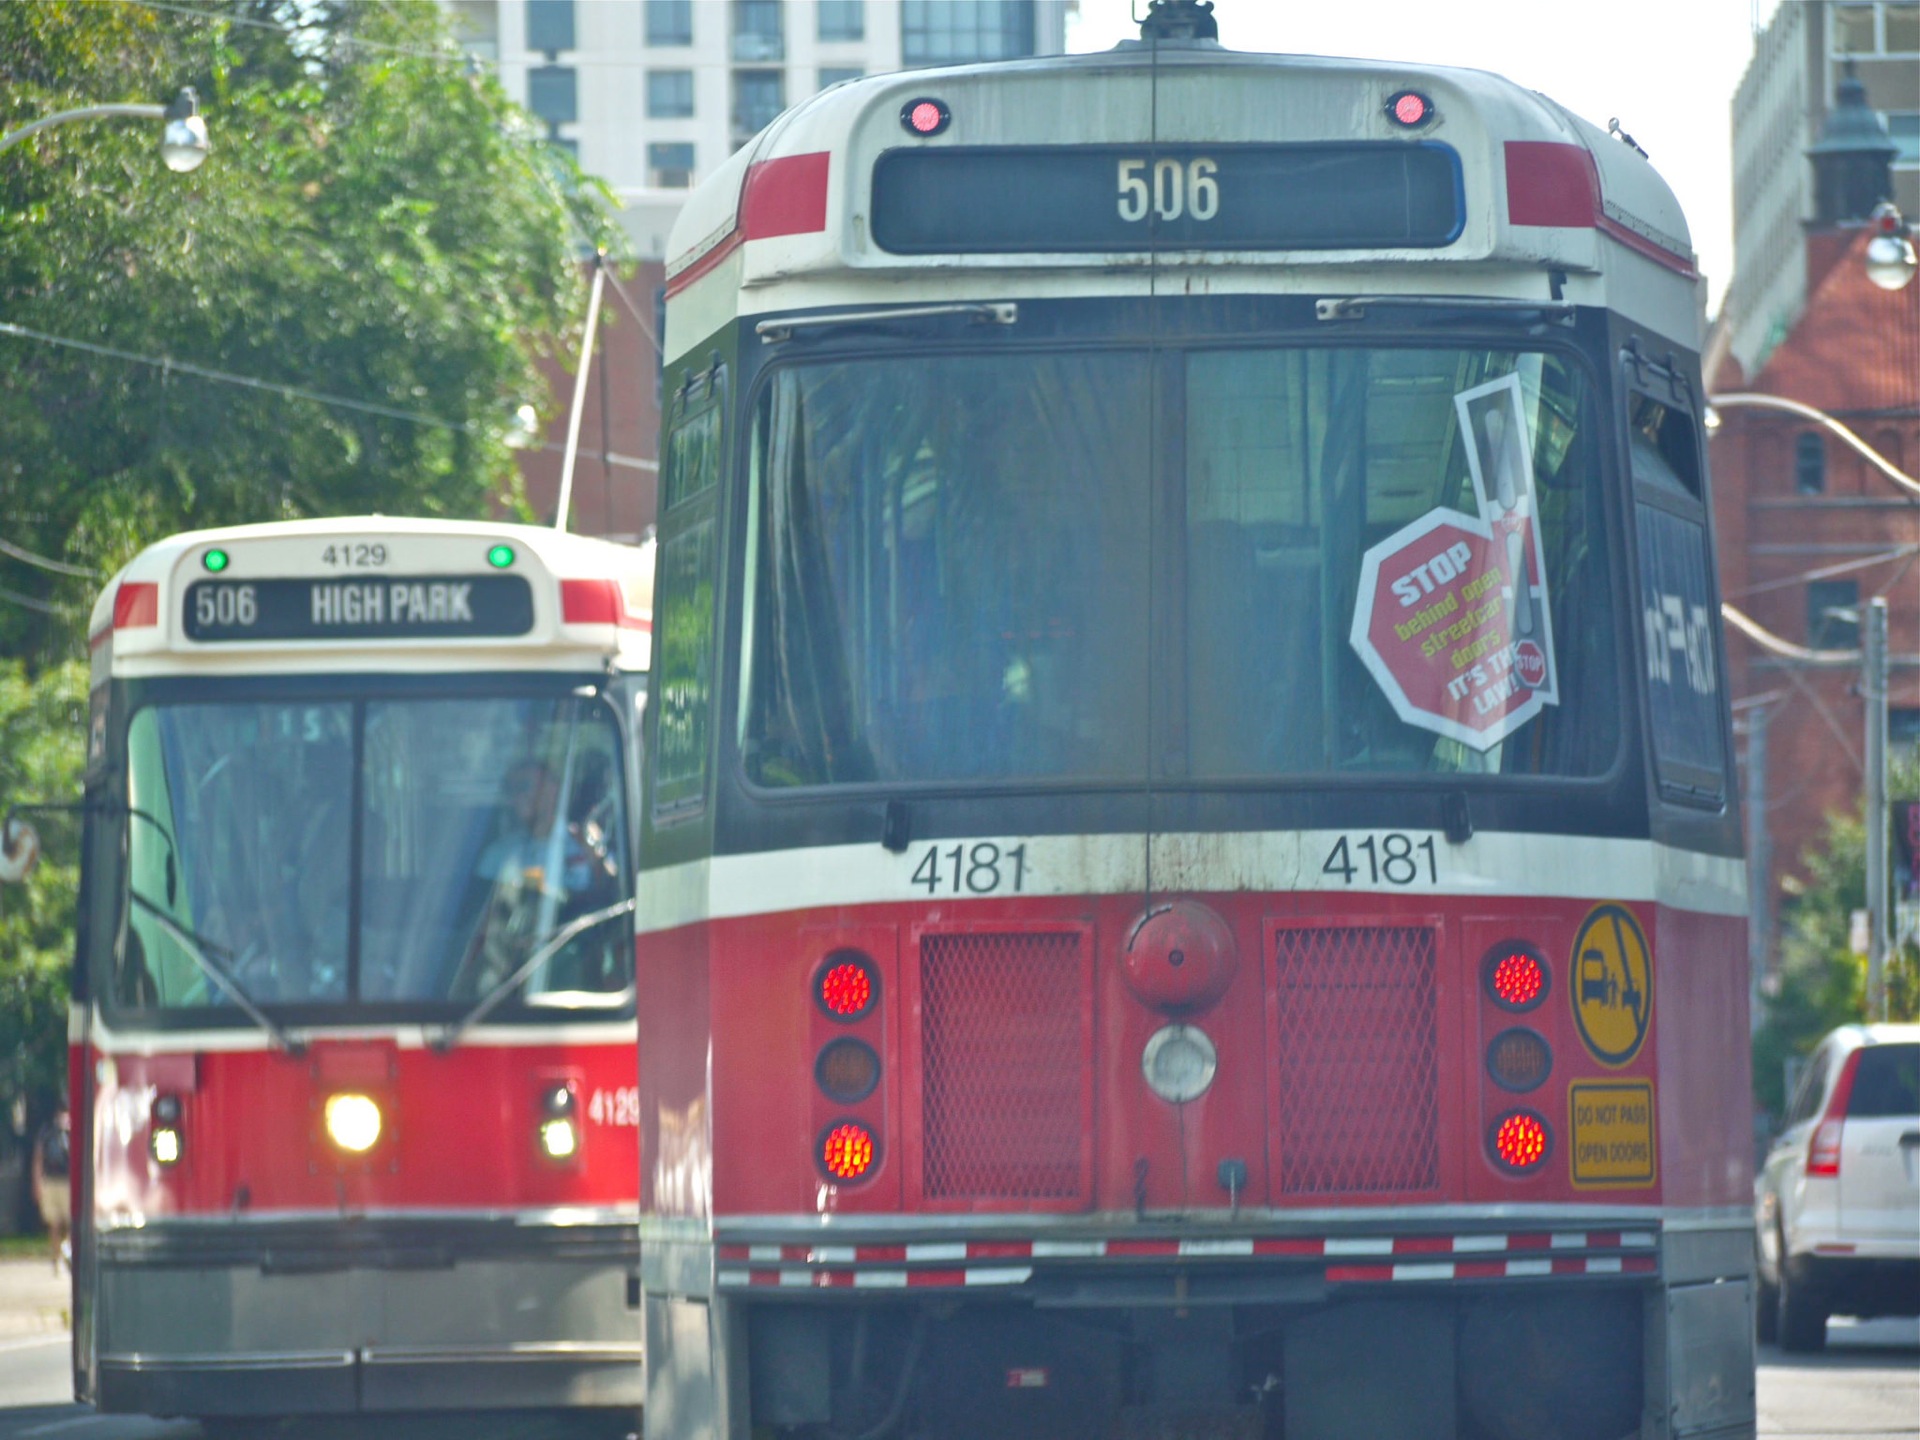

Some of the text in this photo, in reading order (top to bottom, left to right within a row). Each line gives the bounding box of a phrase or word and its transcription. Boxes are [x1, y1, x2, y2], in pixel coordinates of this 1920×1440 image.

[1117, 157, 1219, 222] 506
[322, 544, 386, 566] 4129
[1391, 540, 1472, 607] STOP
[196, 585, 256, 625] 506
[311, 583, 472, 624] HIGH PARK
[1394, 566, 1502, 641] behind open
[1420, 596, 1502, 657] streetcar
[1450, 628, 1501, 669] doors
[1447, 663, 1488, 701] IT'S
[1472, 671, 1519, 715] LAW!
[911, 843, 1024, 893] 4181
[1323, 833, 1437, 883] 4181
[1577, 1105, 1593, 1126] DO
[1595, 1105, 1617, 1126] NOT
